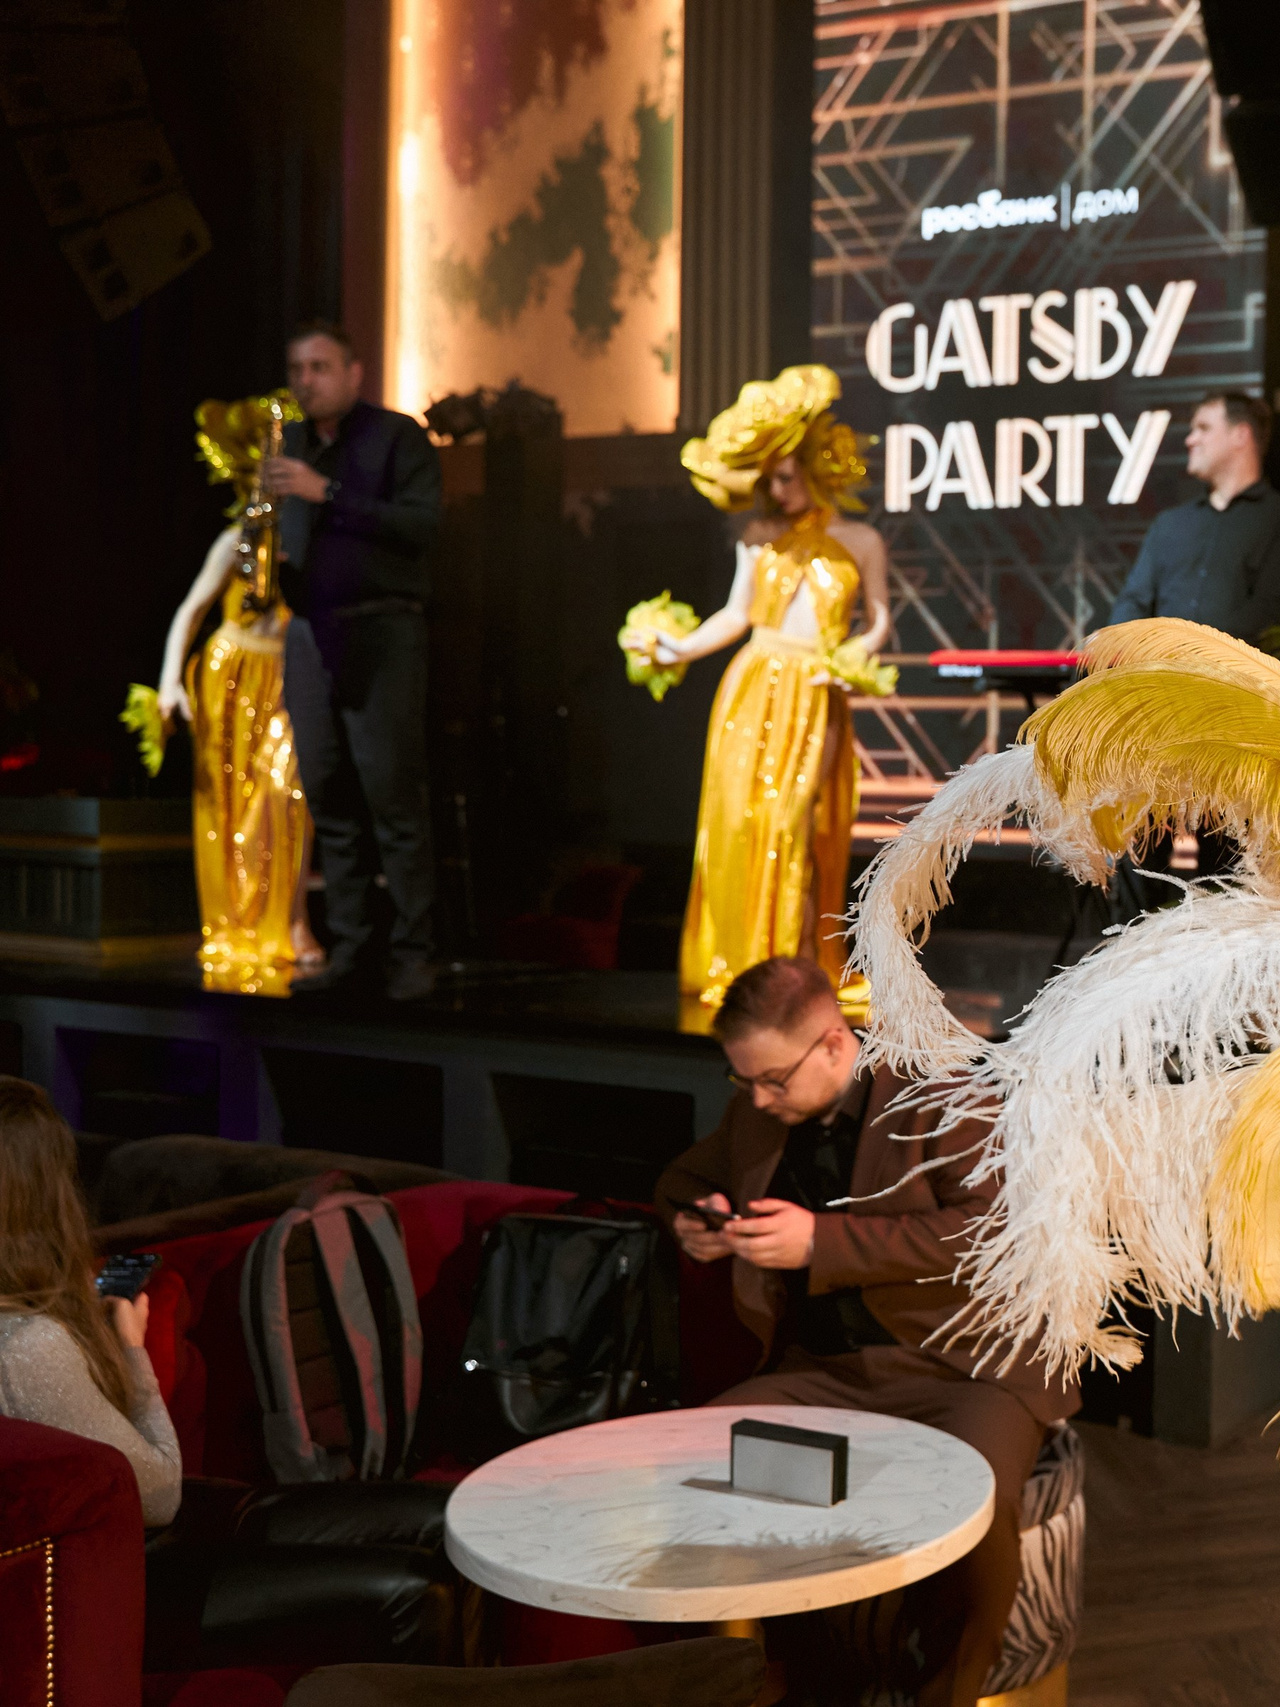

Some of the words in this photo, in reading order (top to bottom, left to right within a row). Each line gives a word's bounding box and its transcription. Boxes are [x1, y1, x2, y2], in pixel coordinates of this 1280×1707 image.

[921, 188, 1057, 241] росбанк
[1072, 186, 1139, 224] дом
[865, 279, 1197, 393] GATSBY
[885, 410, 1172, 513] PARTY
